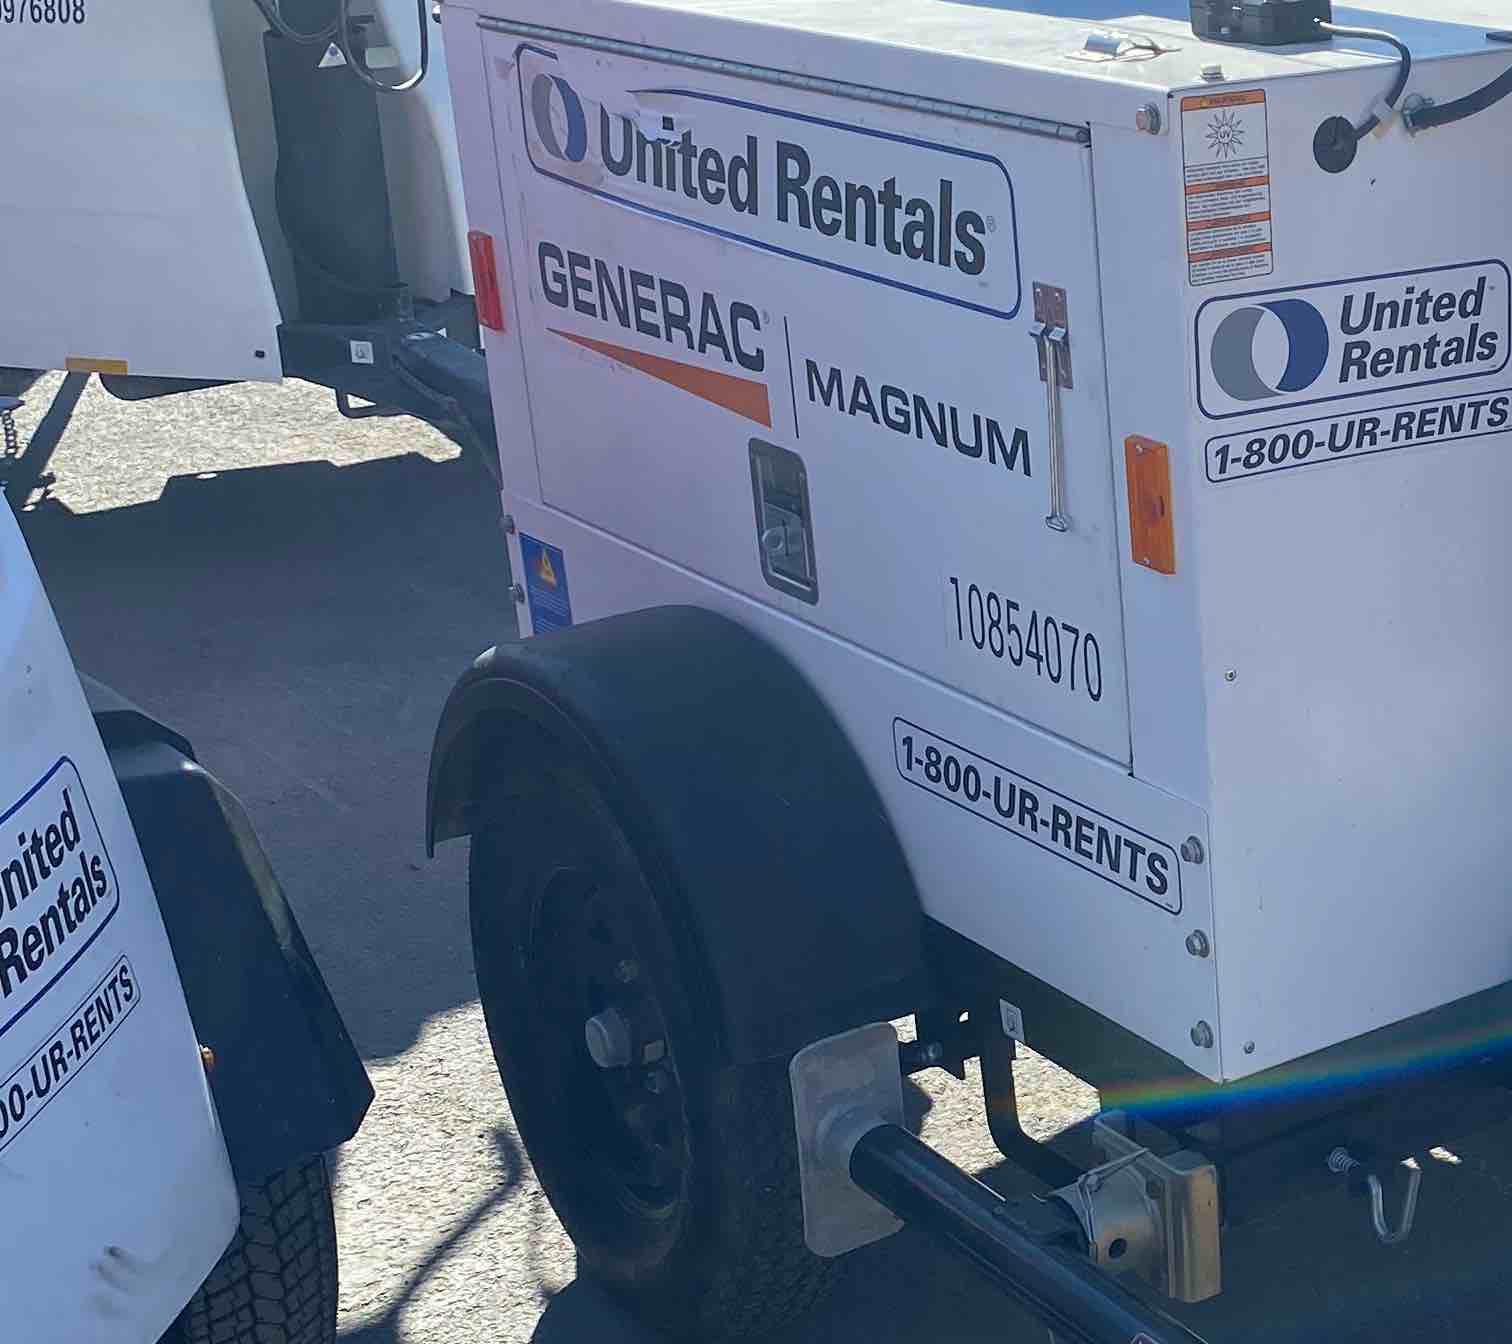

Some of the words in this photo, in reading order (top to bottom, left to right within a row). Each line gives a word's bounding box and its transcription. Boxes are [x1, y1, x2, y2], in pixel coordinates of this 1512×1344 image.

[599, 100, 760, 217] United
[775, 139, 987, 277] Rentals
[537, 240, 765, 373] GENERAC
[1337, 322, 1499, 384] Rentals
[1339, 275, 1487, 336] United
[804, 357, 1033, 479] MAGNUM
[1214, 396, 1510, 475] 1-800-UR-RENTS
[949, 575, 1102, 702] 10854070
[0, 787, 82, 918] nited
[901, 735, 1169, 896] 1-800-UR-RENTS
[0, 851, 107, 1000] Rentals
